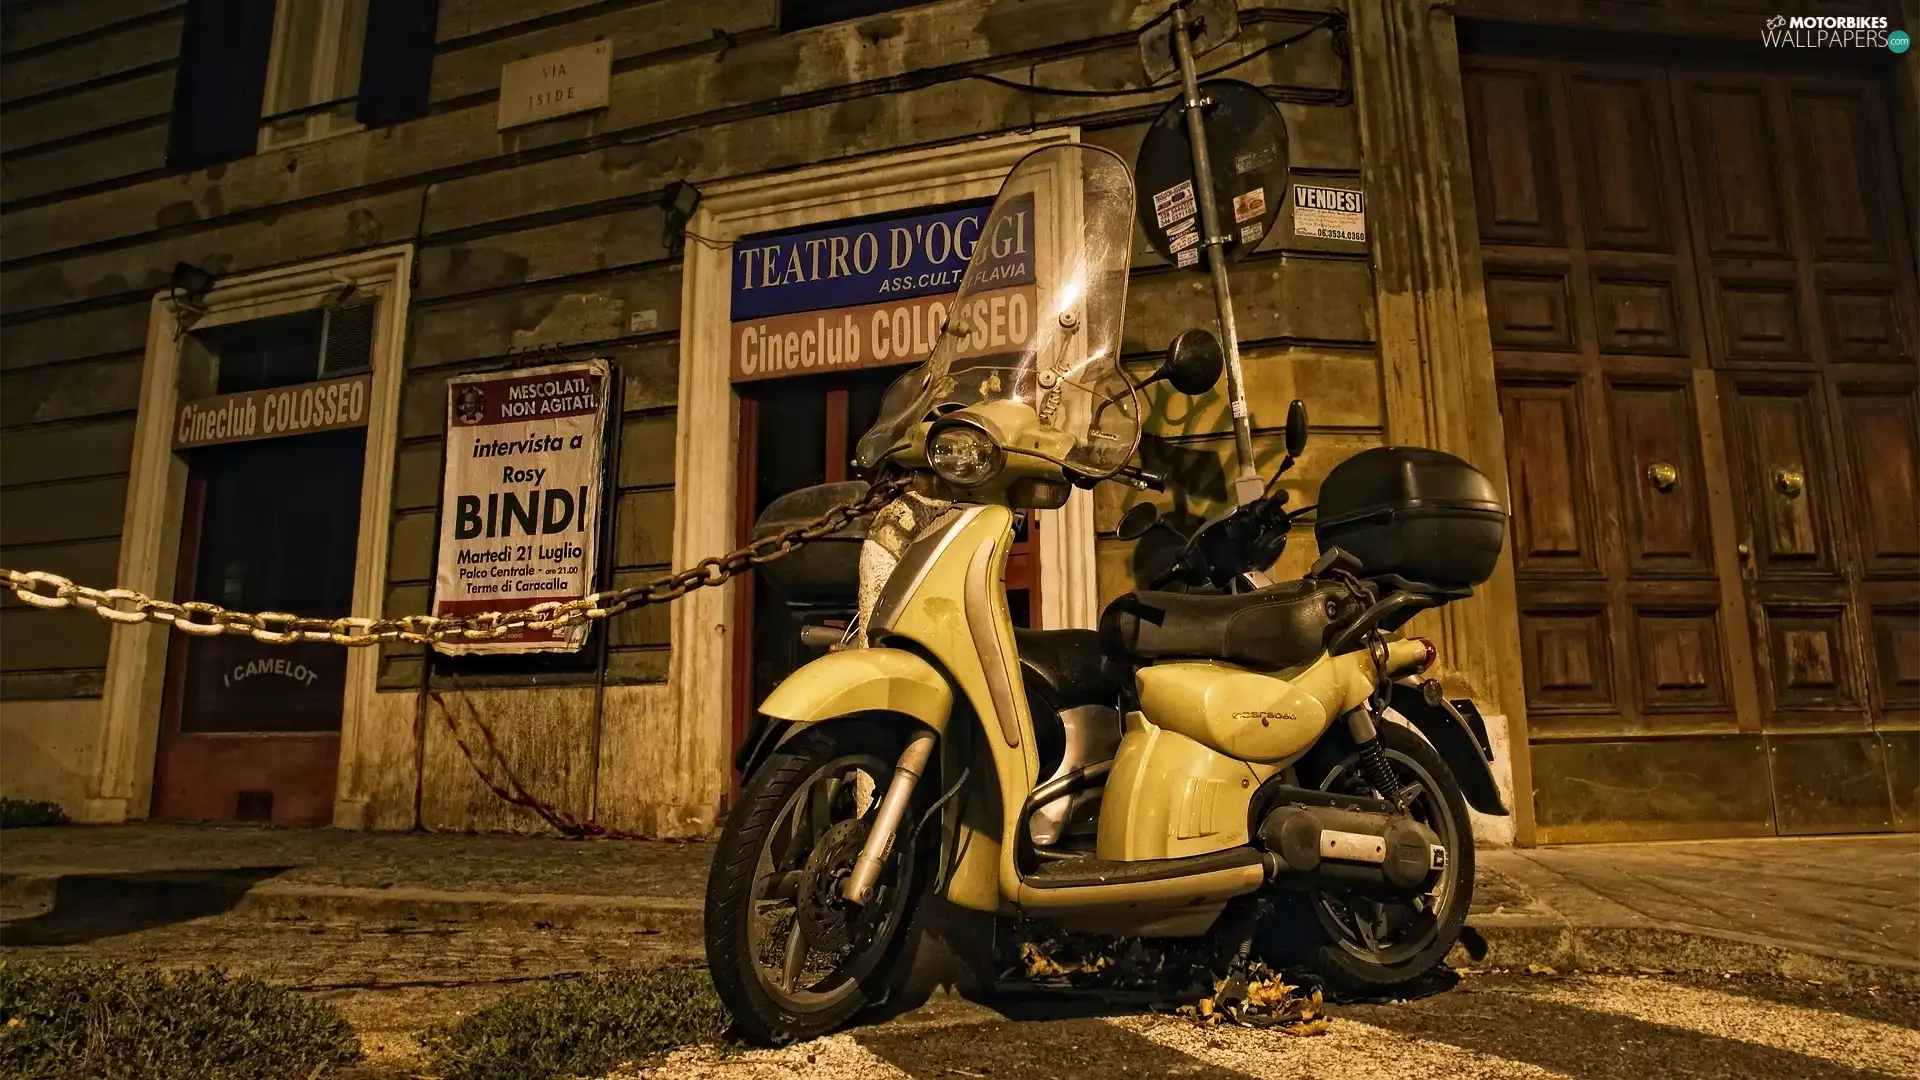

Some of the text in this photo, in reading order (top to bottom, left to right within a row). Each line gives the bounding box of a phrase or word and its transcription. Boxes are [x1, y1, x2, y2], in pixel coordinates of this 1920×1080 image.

[542, 64, 566, 79] VIA
[528, 86, 575, 109] ISIDE
[1296, 187, 1361, 212] VENDESI
[739, 210, 1028, 290] TEATRO D'OGGI
[740, 293, 1028, 375] Cineclub COLOSSEO
[509, 378, 591, 401] MESCOLATI,
[178, 380, 364, 444] Cineclub COLOSSEO
[501, 393, 599, 418] NON AGITATI.
[472, 433, 584, 459] intervista a
[503, 466, 546, 487] Rosy
[455, 485, 588, 540] BINDI
[457, 542, 583, 565] Martedì 21 Luglio
[459, 567, 488, 580] Palco
[490, 564, 535, 578] Centrale
[557, 566, 579, 575] 21.00
[466, 577, 568, 594] Terme di Caracalla
[223, 658, 318, 687] I CAMELOT
